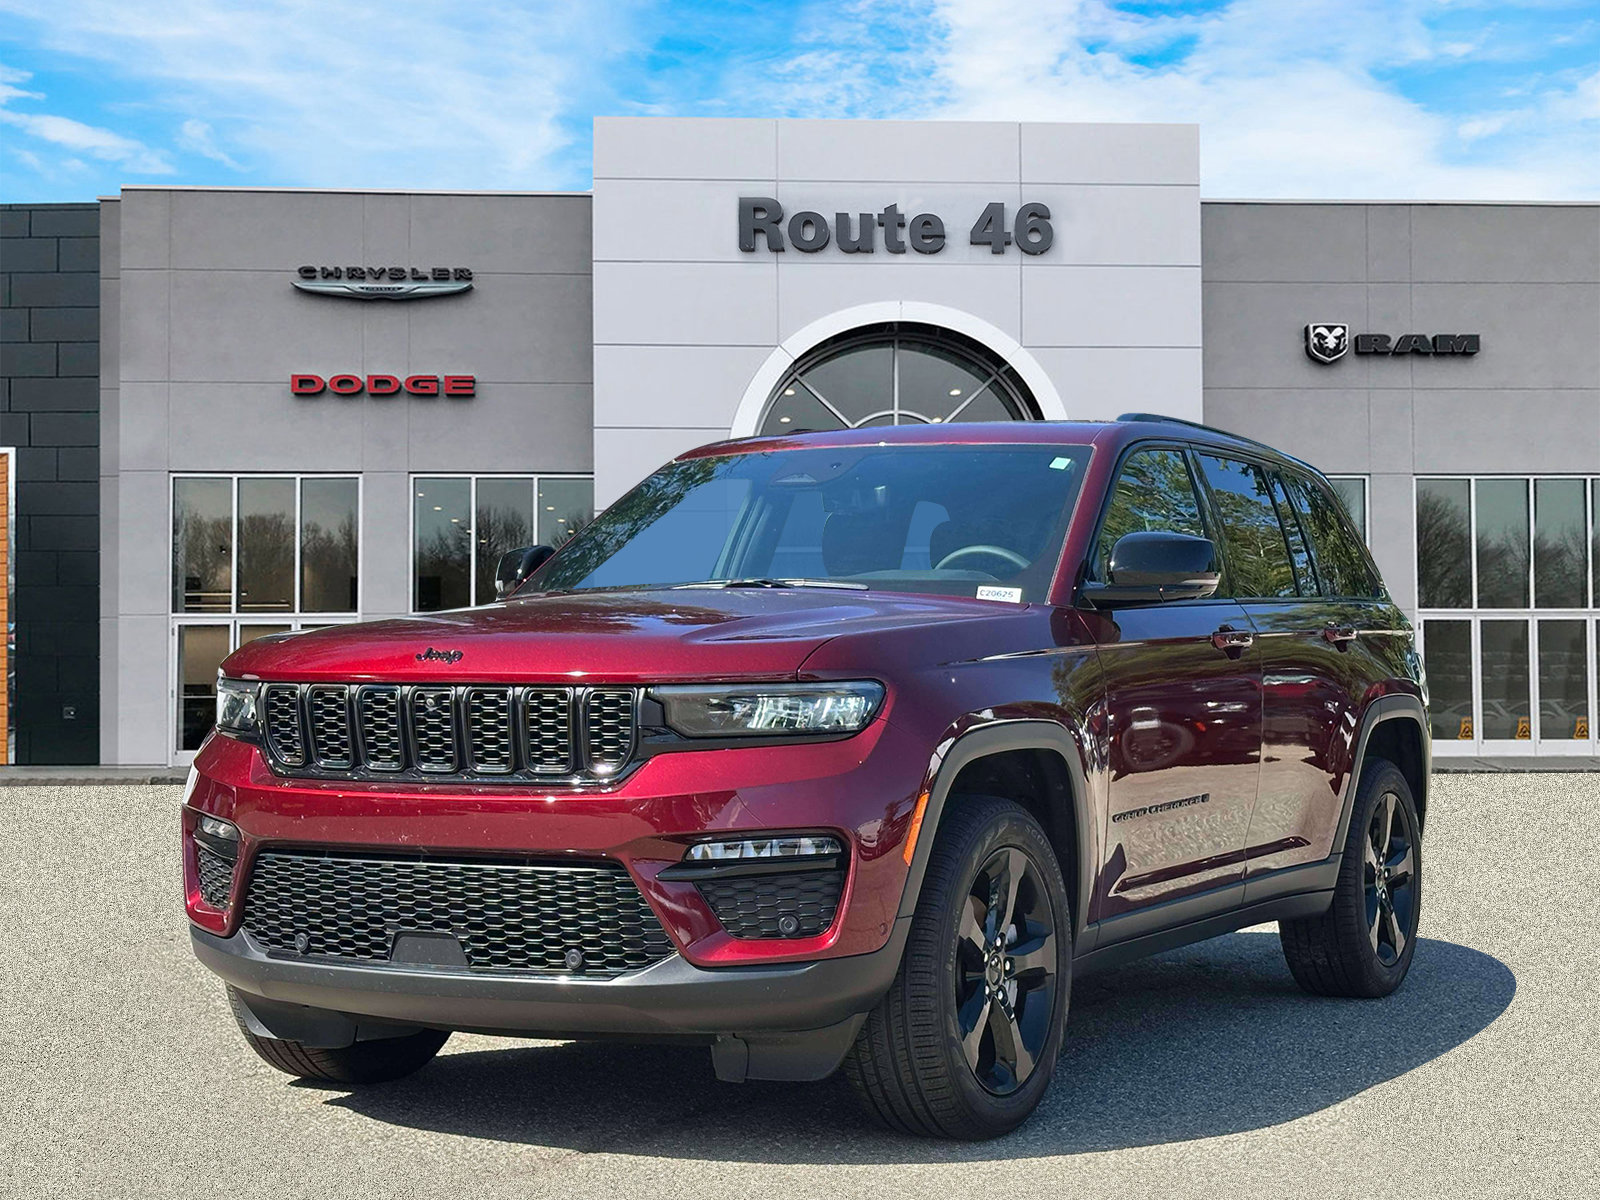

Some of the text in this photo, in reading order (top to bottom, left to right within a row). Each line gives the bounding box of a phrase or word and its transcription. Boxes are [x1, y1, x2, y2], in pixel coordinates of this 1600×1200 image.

[738, 197, 1055, 255] Route 46
[298, 266, 473, 281] CHRYSLER
[1354, 334, 1481, 355] RAM
[290, 374, 477, 397] DODGE
[415, 647, 463, 664] Jeep
